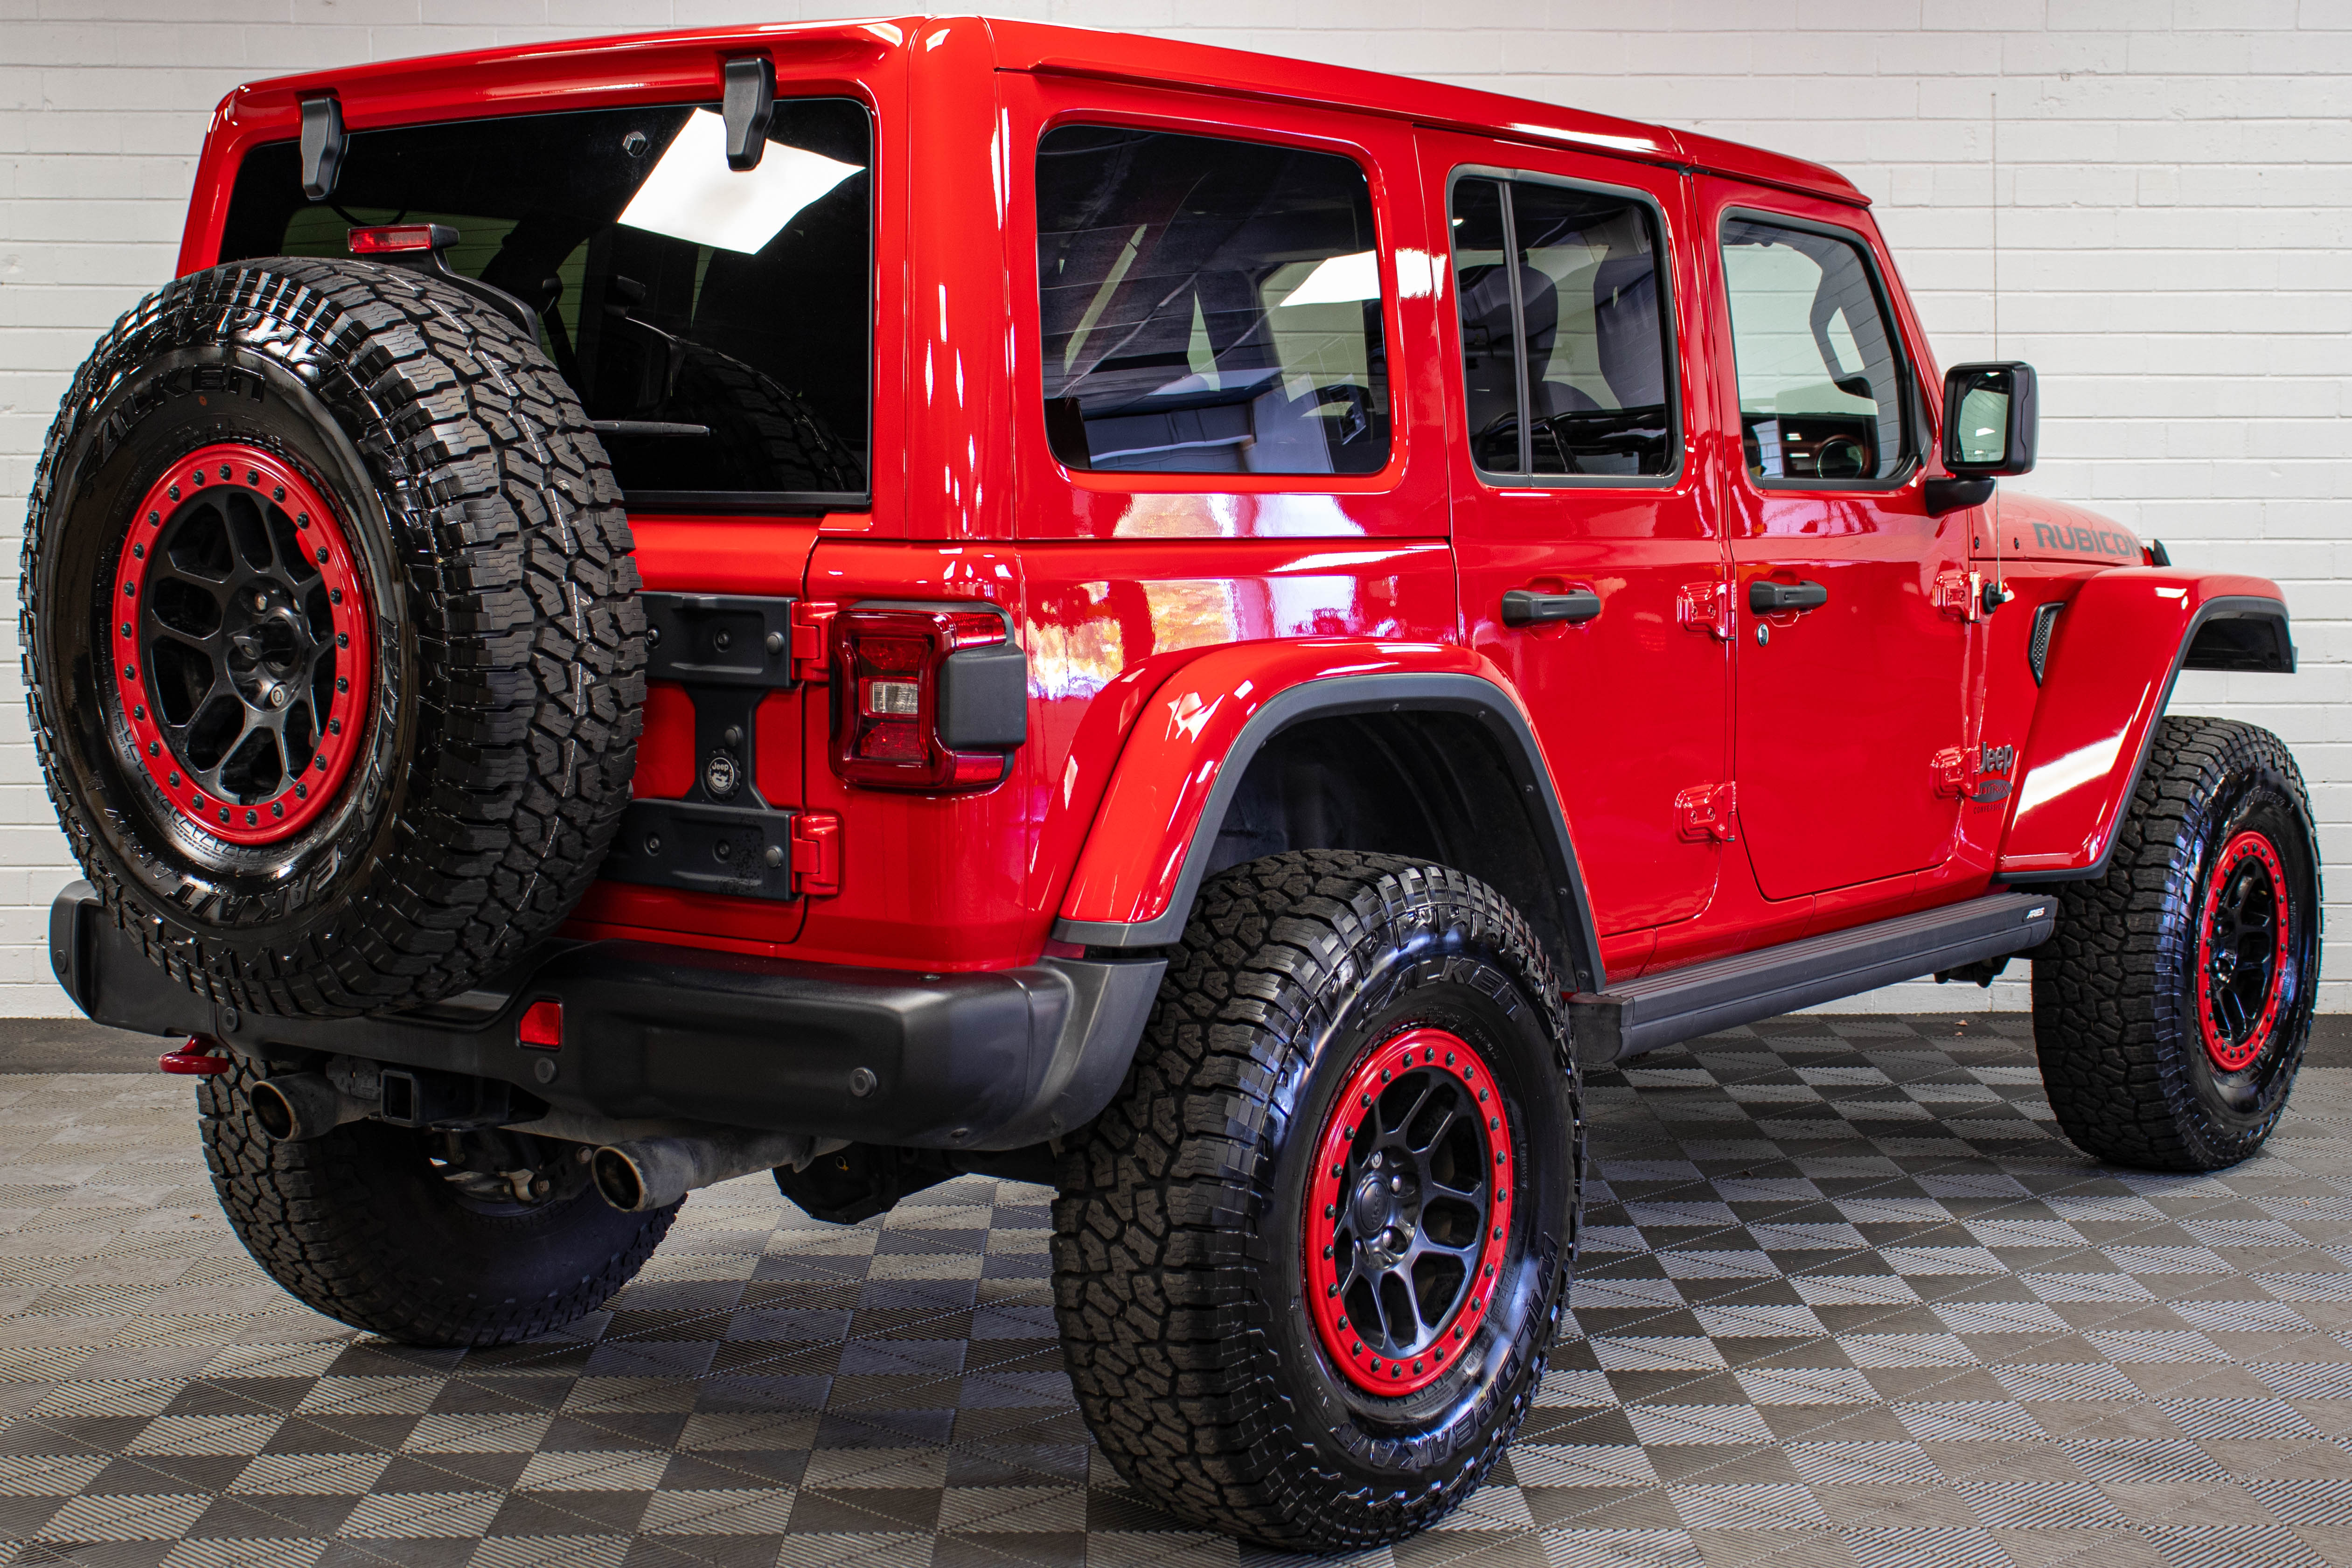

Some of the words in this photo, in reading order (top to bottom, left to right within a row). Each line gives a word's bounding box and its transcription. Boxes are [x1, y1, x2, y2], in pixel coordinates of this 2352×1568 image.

[76, 363, 266, 498] FALKEN
[2032, 523, 2145, 558] RUBICON
[712, 762, 729, 772] Jeep
[1979, 741, 2014, 775] Jeep
[1974, 802, 2006, 815] CONVERSIONS
[1355, 955, 1527, 1031] FALKEN
[1399, 1232, 1559, 1470] WILDPEAK
